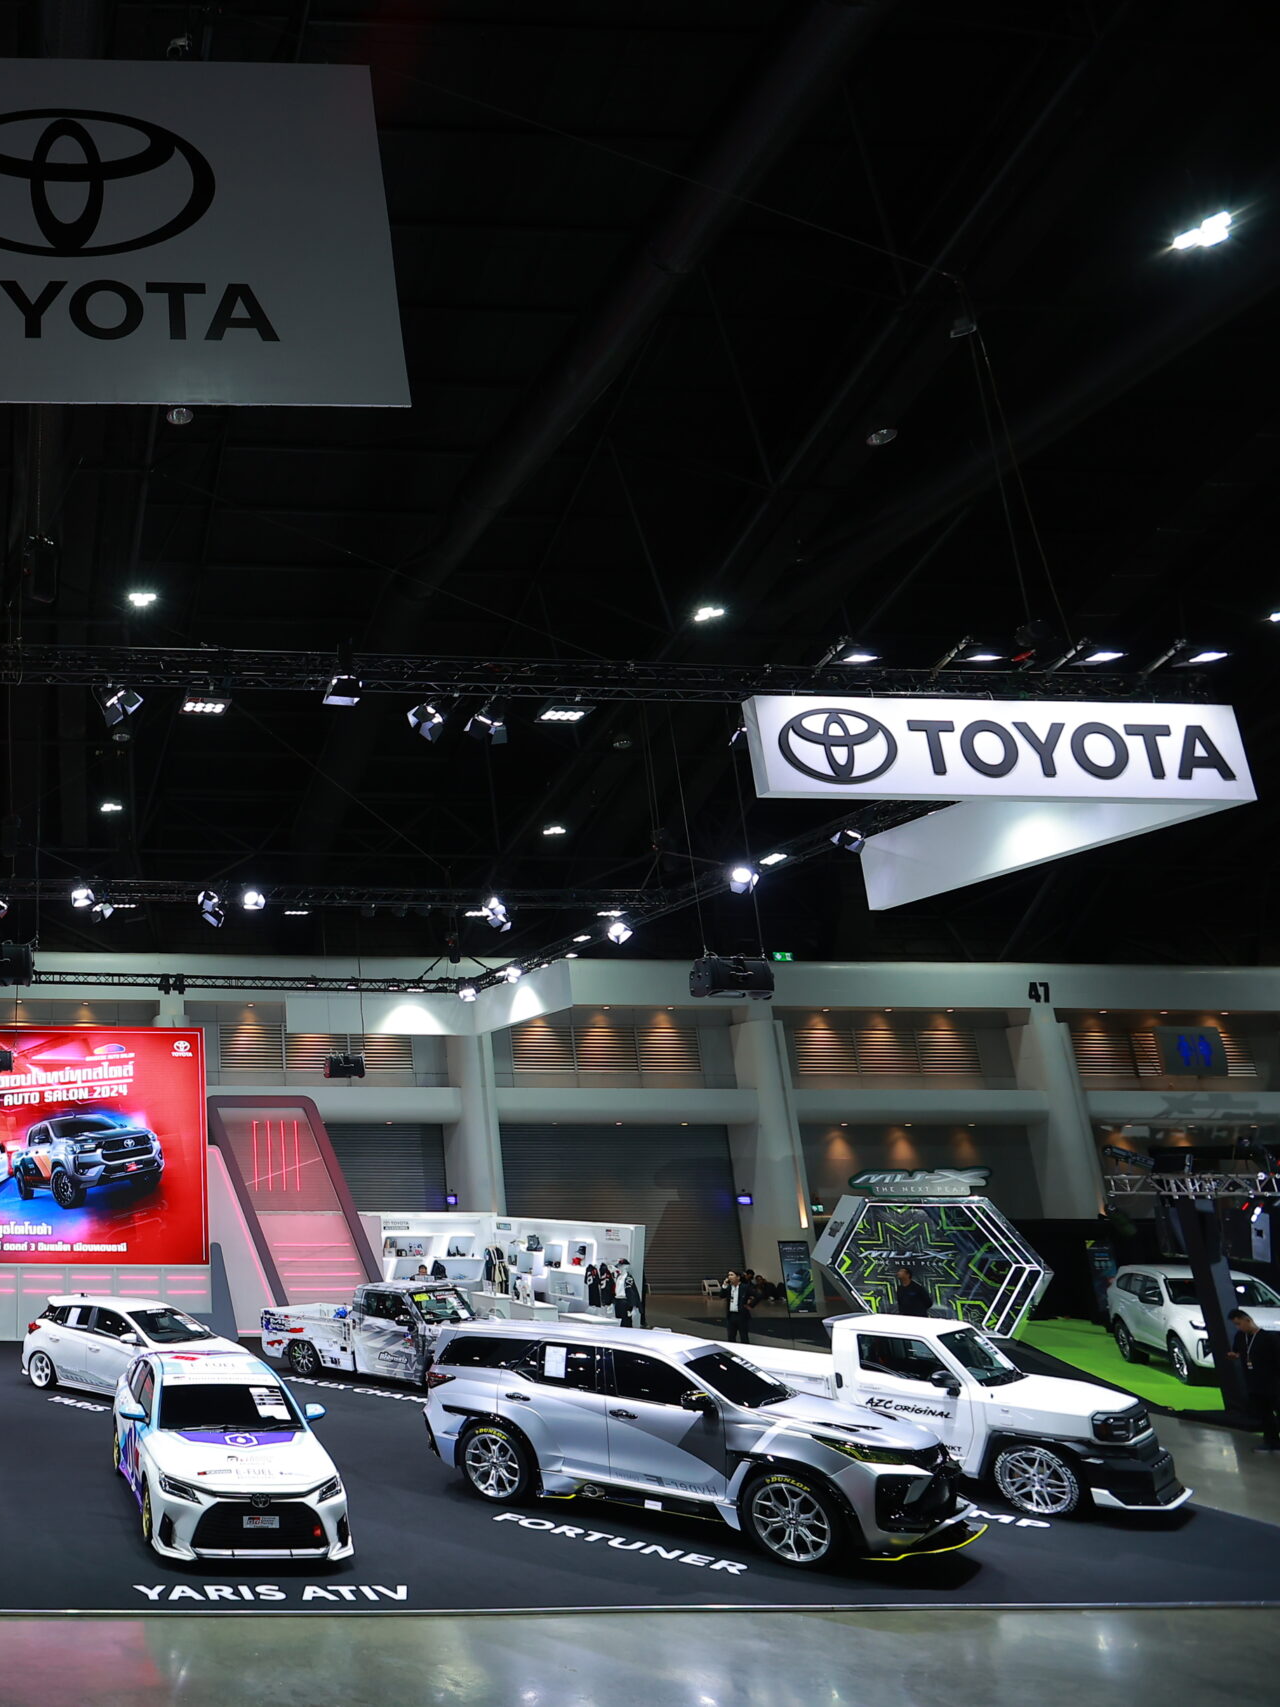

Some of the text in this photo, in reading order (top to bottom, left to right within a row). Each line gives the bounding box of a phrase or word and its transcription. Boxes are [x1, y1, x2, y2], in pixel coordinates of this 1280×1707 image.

[906, 719, 1237, 782] TOYOTA
[1028, 982, 1050, 1003] 47
[3, 1091, 40, 1106] AUTO
[44, 1088, 89, 1103] SALON
[93, 1084, 128, 1099] 2024
[47, 1396, 112, 1412] YARIS
[865, 1397, 893, 1410] AZC
[479, 1427, 508, 1441] DUNLOP
[770, 1476, 811, 1492] DUNLOP
[492, 1512, 749, 1576] FORTUNER
[133, 1585, 409, 1601] YARIS ATIV
